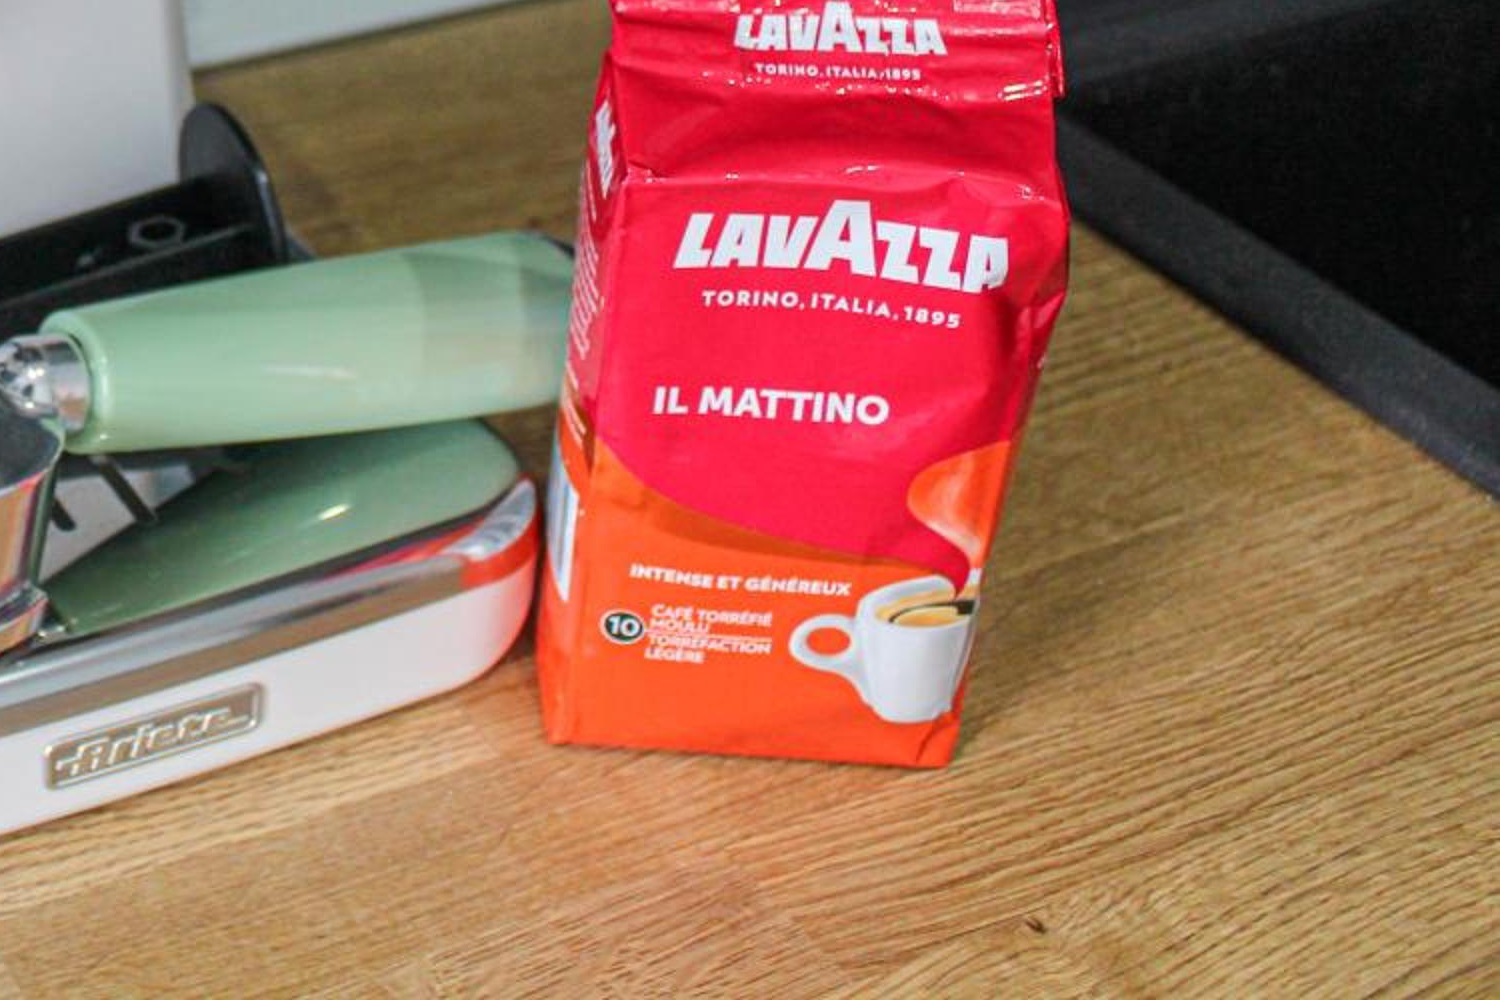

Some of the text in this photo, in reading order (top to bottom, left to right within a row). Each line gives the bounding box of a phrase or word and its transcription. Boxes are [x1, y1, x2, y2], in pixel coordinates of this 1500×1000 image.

[734, 1, 948, 56] LAVAZZA
[673, 199, 1010, 293] LAVAZZA
[702, 290, 961, 329] TORINO, ITALIA, 1895
[653, 386, 889, 425] IL MATTINO
[629, 563, 852, 597] INTENSE ET GÉNÉREUX
[608, 615, 641, 637] 10
[651, 603, 693, 620] CAFÉ
